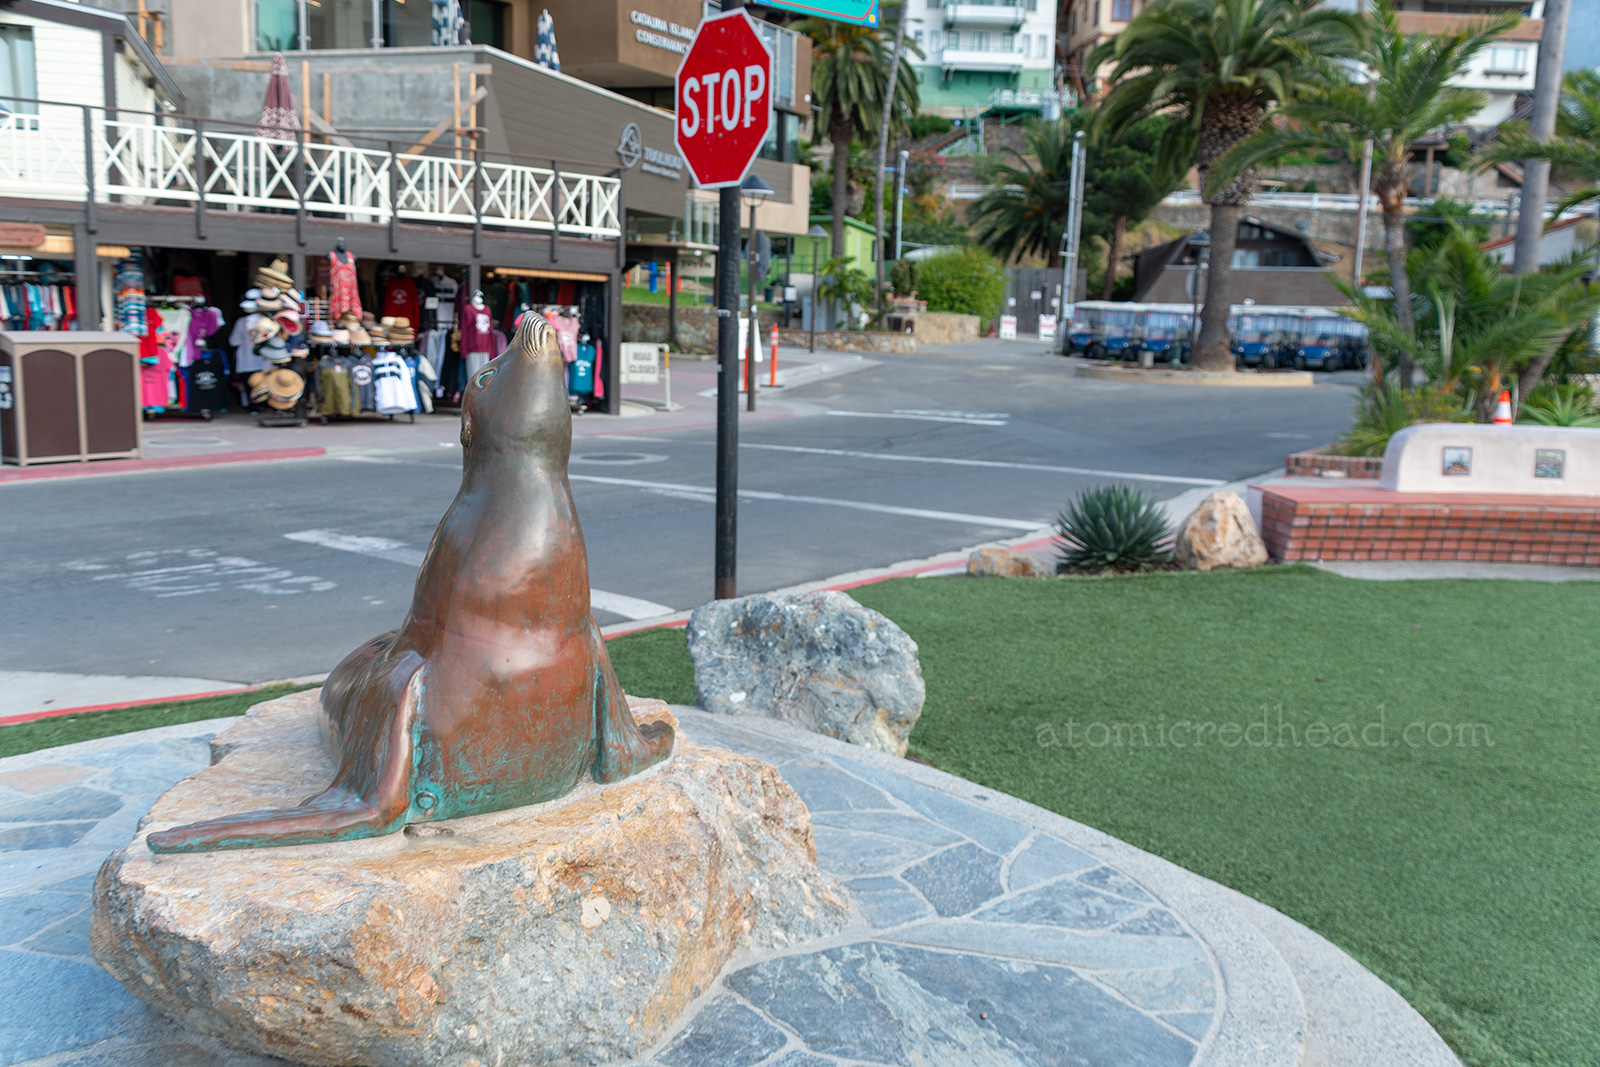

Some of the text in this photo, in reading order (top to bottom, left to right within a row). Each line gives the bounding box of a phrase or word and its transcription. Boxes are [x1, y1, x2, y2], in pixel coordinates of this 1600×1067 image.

[630, 10, 697, 41] CATALINA ISLAND
[681, 64, 766, 138] STOP
[632, 351, 652, 361] ROAD
[630, 364, 657, 374] CLOSED
